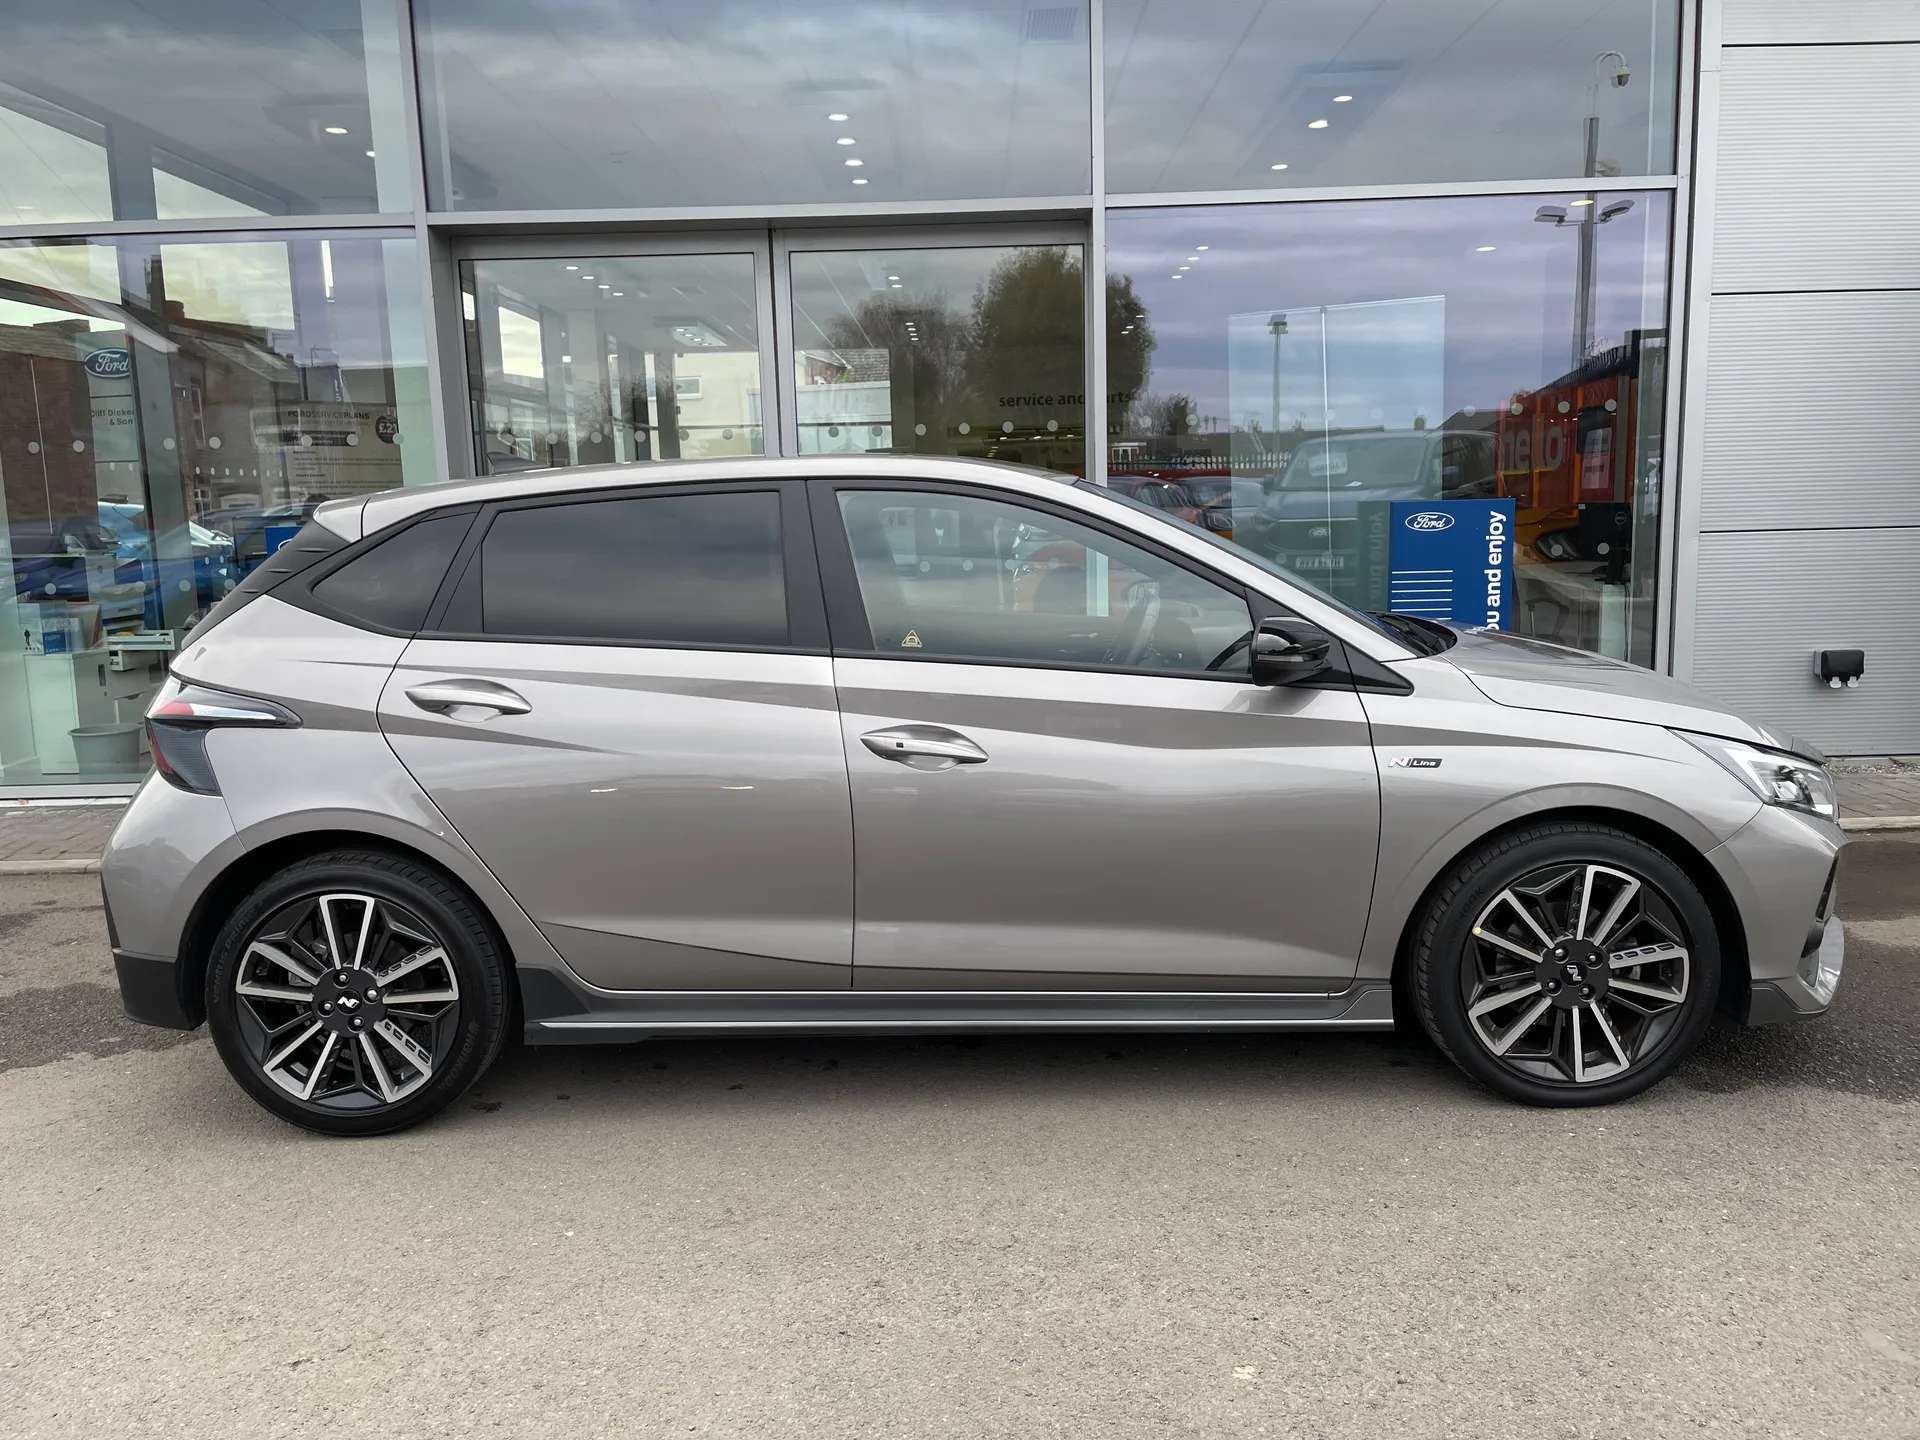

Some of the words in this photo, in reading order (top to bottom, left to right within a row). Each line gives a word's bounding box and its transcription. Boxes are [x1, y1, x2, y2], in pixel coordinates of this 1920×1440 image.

[95, 353, 129, 372] Ford
[999, 392, 1052, 407] service
[1413, 514, 1446, 529] Ford
[1486, 511, 1507, 566] enjoy
[1484, 569, 1502, 608] and
